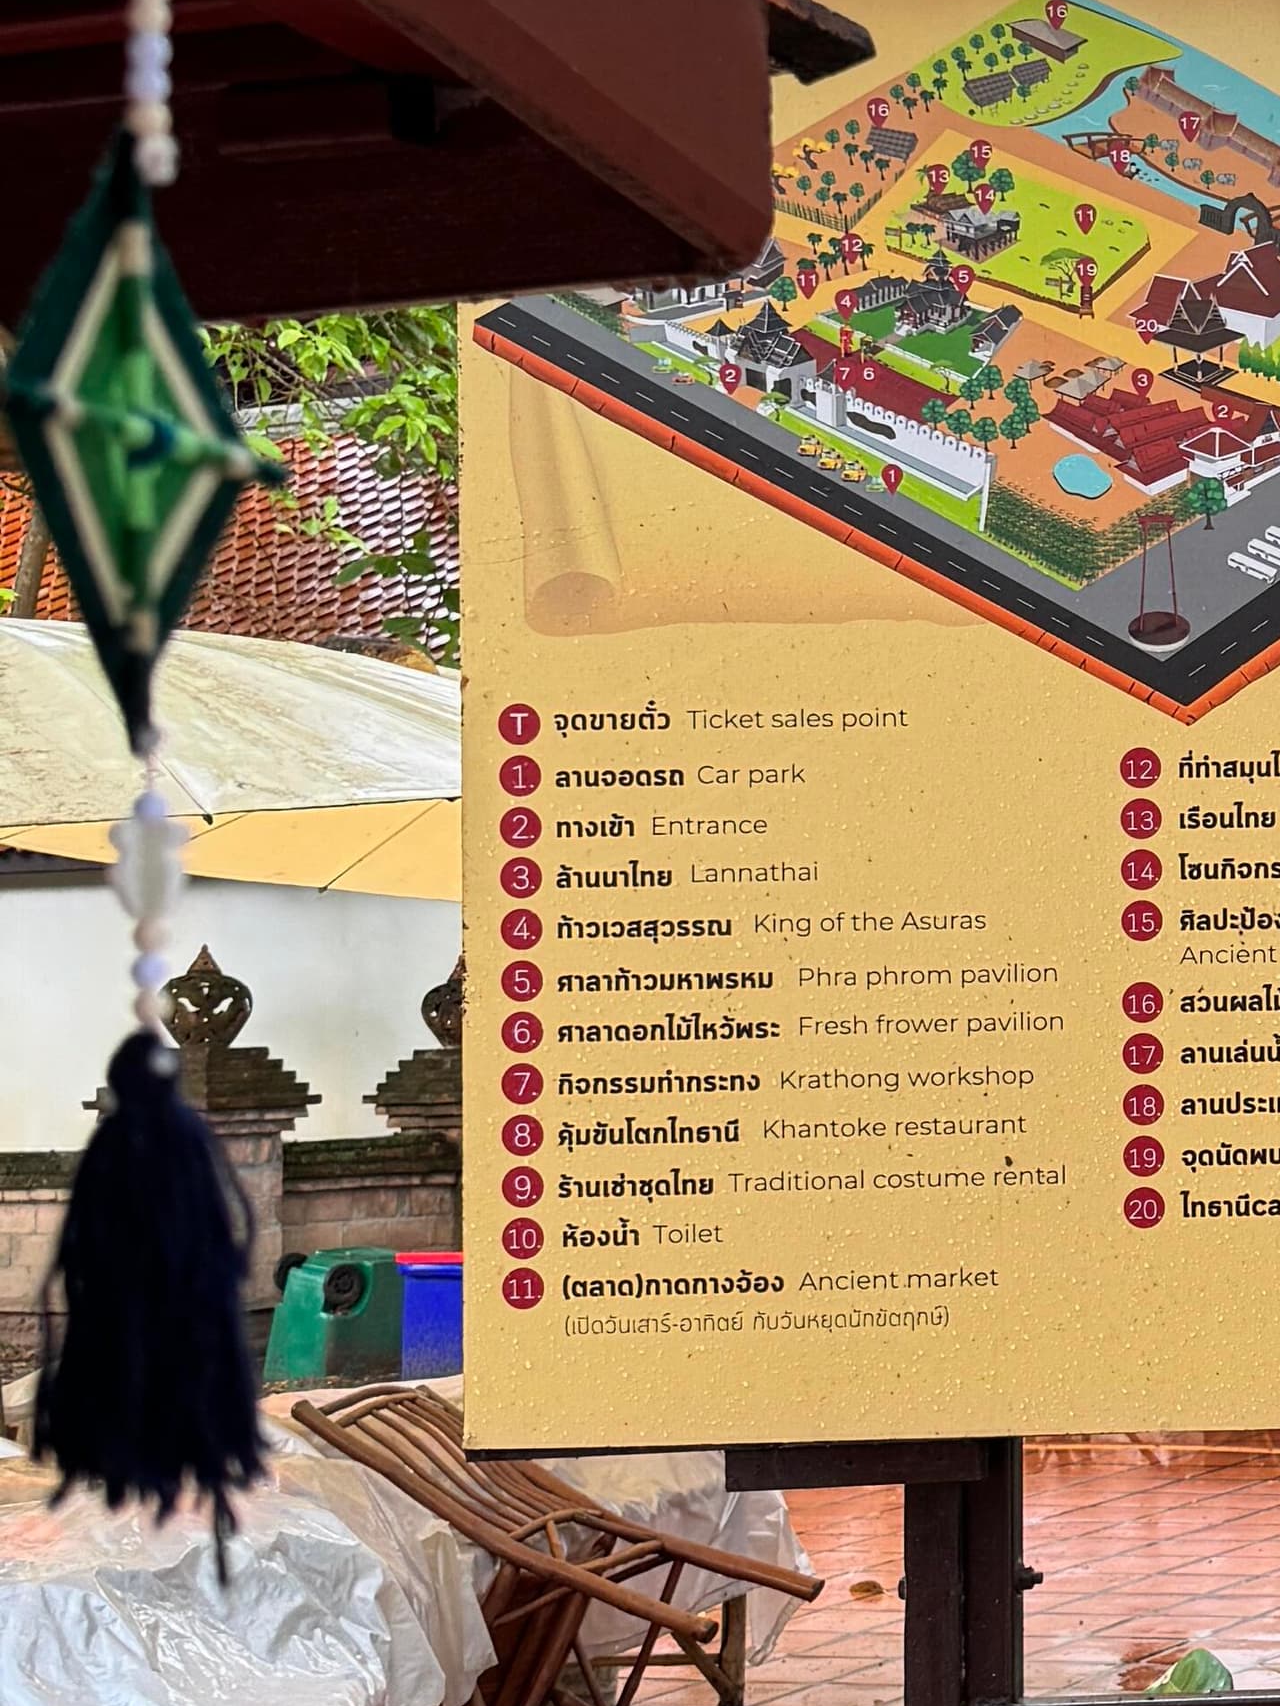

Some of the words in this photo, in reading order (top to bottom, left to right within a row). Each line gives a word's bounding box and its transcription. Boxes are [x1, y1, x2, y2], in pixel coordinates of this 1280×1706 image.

[554, 700, 670, 738] จุดขายตั๋ว
[687, 709, 764, 729] Ticket
[772, 709, 833, 727] sales
[843, 710, 908, 732] point
[556, 770, 684, 787] ลานจอดรถ
[698, 766, 740, 784] Car
[749, 764, 805, 788] park
[557, 813, 634, 837] ทางเข้า
[653, 817, 767, 835] Entrance
[1180, 802, 1275, 829] เรือนไทย
[557, 860, 672, 888] ล้านนาไทย
[692, 862, 817, 882] Lannathai
[755, 914, 810, 938] King
[821, 912, 845, 932] of
[851, 912, 893, 931] the
[901, 912, 986, 930] Asuras
[1180, 942, 1277, 964] Ancient
[558, 968, 773, 992] ศาลาท้าวมหาพรหม
[800, 967, 856, 986] Phra
[867, 965, 951, 990] phrom
[962, 964, 1057, 988] pavilion
[558, 1013, 780, 1042] ศาลาดอกไม้ไหว้พระ
[800, 1015, 867, 1036] Fresh
[876, 1014, 958, 1033] frower
[968, 1012, 1063, 1037] pavilion
[559, 1070, 760, 1094] กิจกรรมทำกระทง
[781, 1069, 899, 1092] Krathong
[908, 1066, 1033, 1089] workshop
[559, 1116, 739, 1152] คุ้มขันโตกไทธานี
[764, 1117, 886, 1138] Khantoke
[896, 1116, 1027, 1136] restaurant
[563, 1218, 639, 1247] ห้องน้ำ
[653, 1224, 723, 1244] Toilet
[799, 1272, 898, 1291] Ancient
[908, 1267, 999, 1288] market
